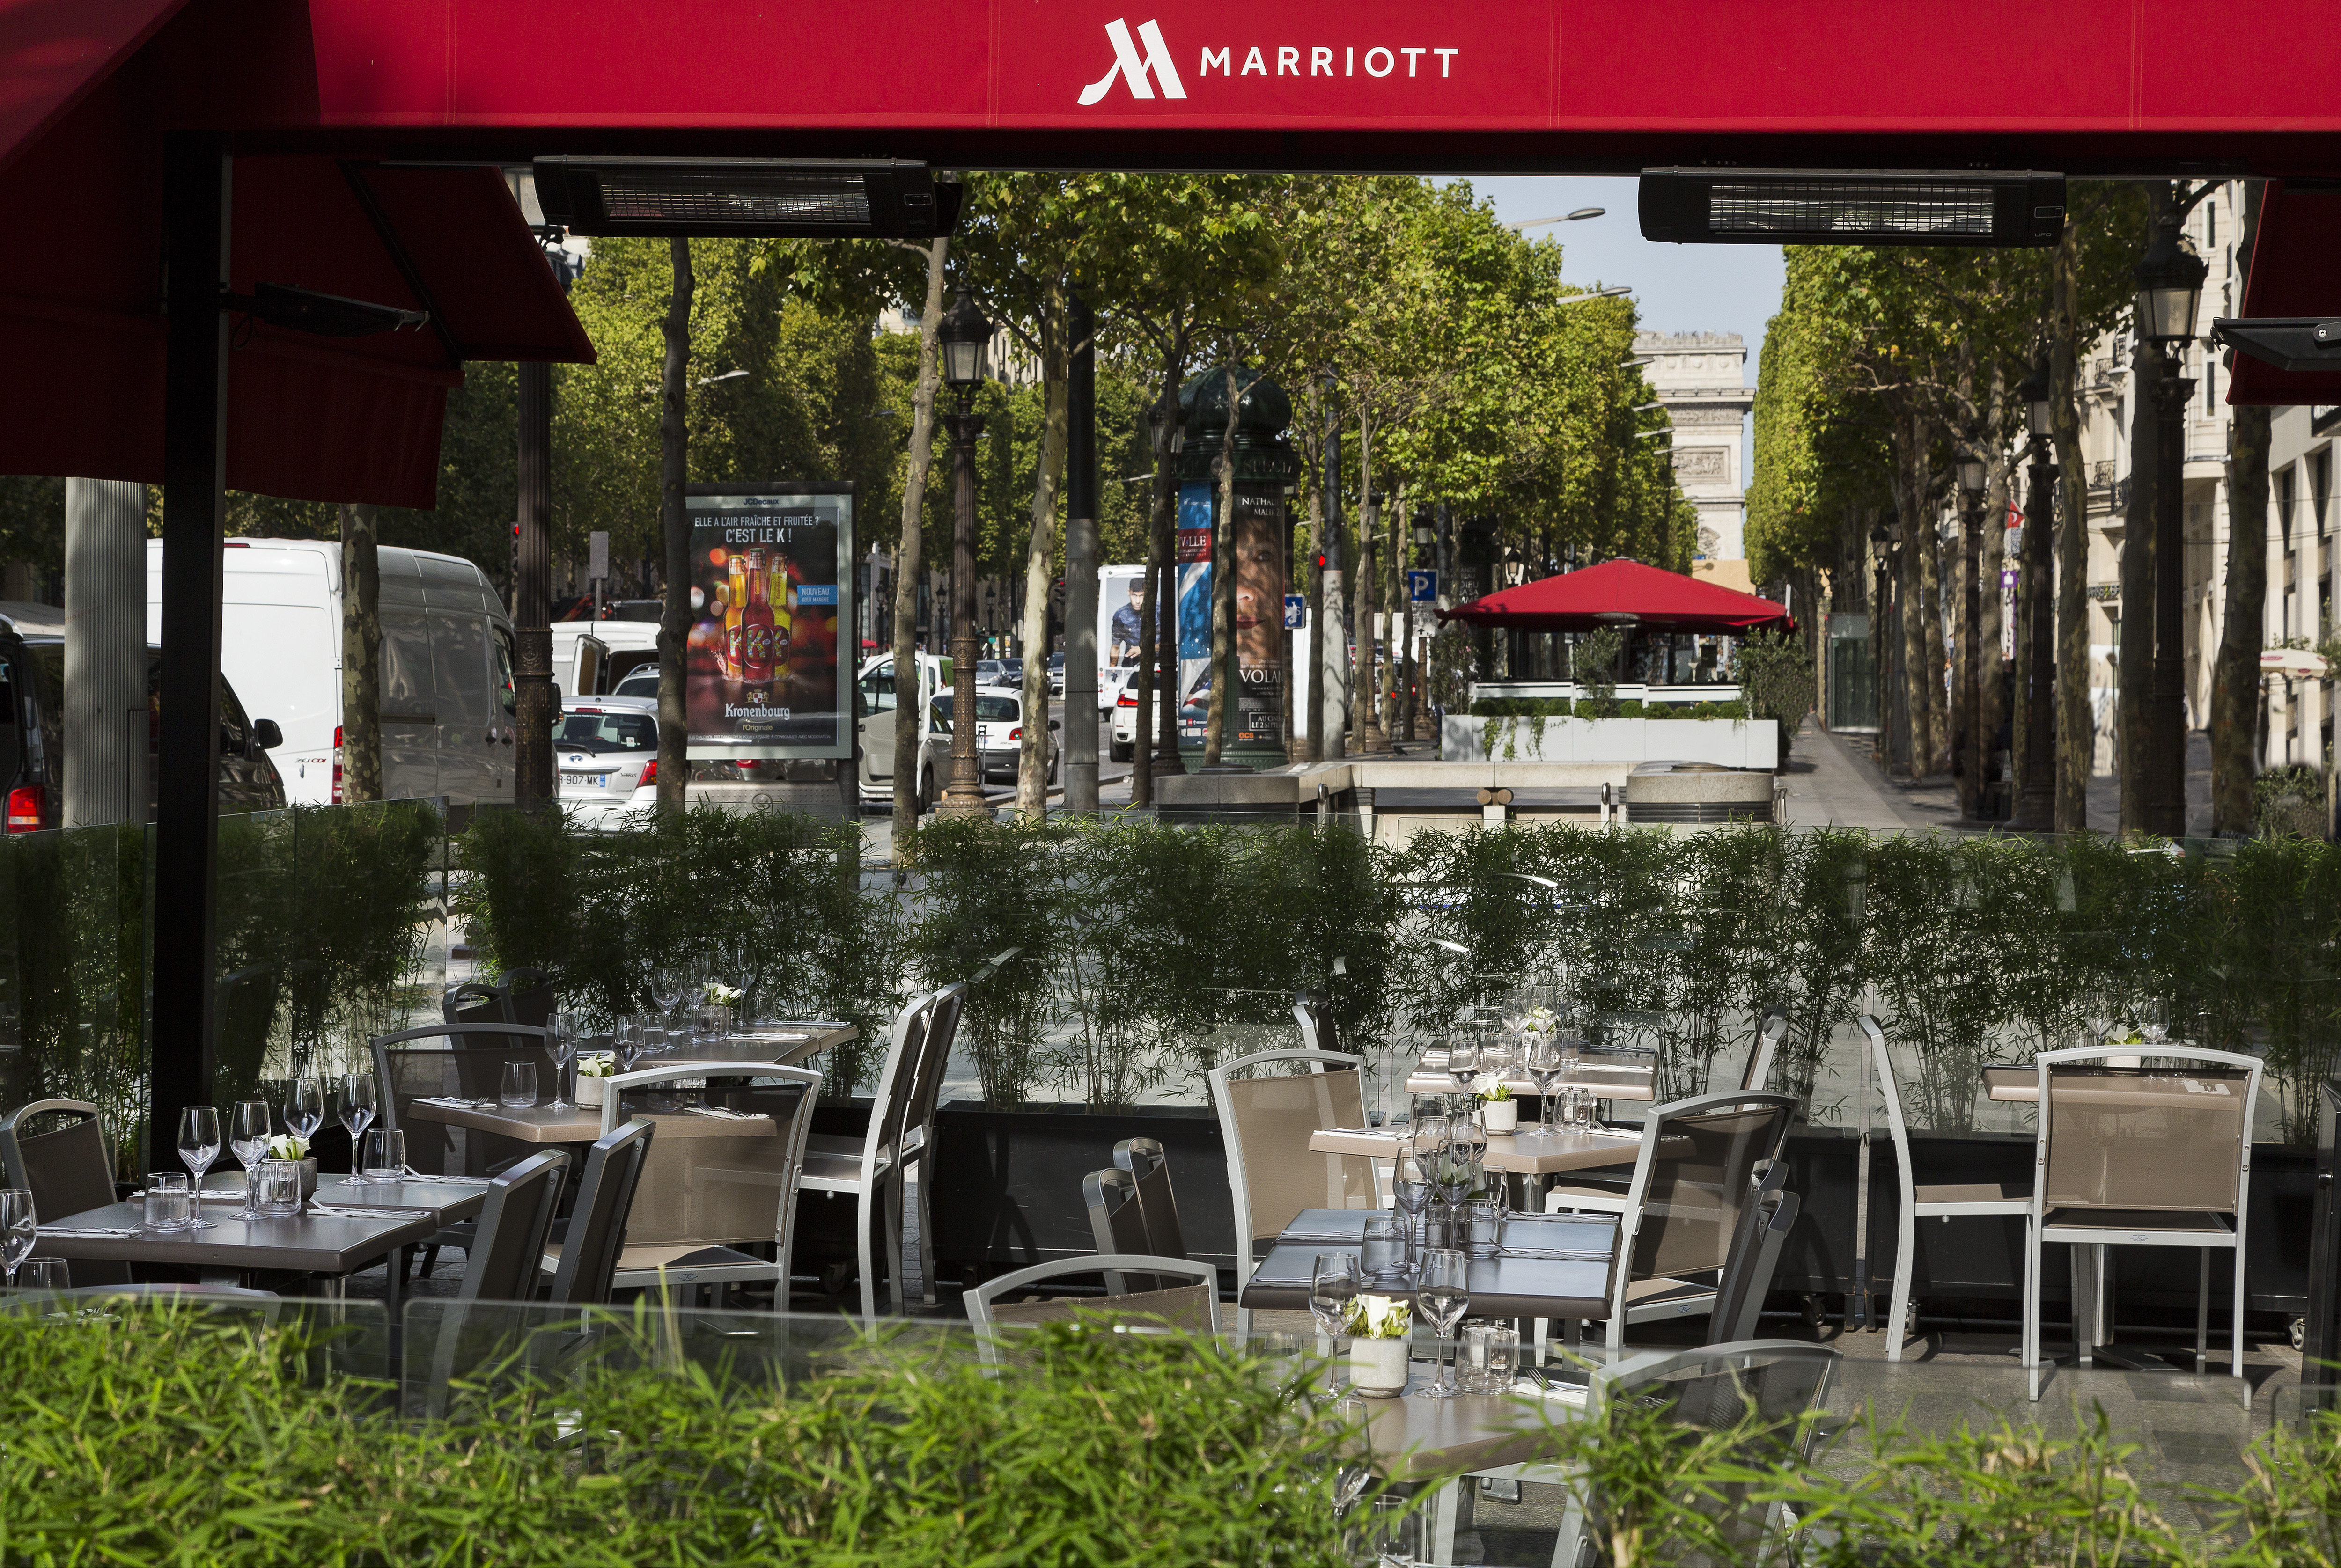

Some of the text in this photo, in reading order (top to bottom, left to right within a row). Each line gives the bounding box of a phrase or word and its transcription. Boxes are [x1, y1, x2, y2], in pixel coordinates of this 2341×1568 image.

[1200, 46, 1459, 78] MARRIOTT
[695, 517, 712, 527] ELLE
[714, 518, 719, 527] A
[721, 517, 738, 526] L'AIR
[740, 515, 771, 526] FRAÎCHE
[773, 517, 781, 526] ET
[784, 514, 813, 526] FRUITÉE
[726, 528, 756, 542] C'EST
[759, 528, 773, 542] LE
[777, 528, 785, 542] K
[1415, 576, 1428, 596] P
[725, 703, 790, 720] Kronenbourg
[559, 775, 598, 785] R-907-MK
